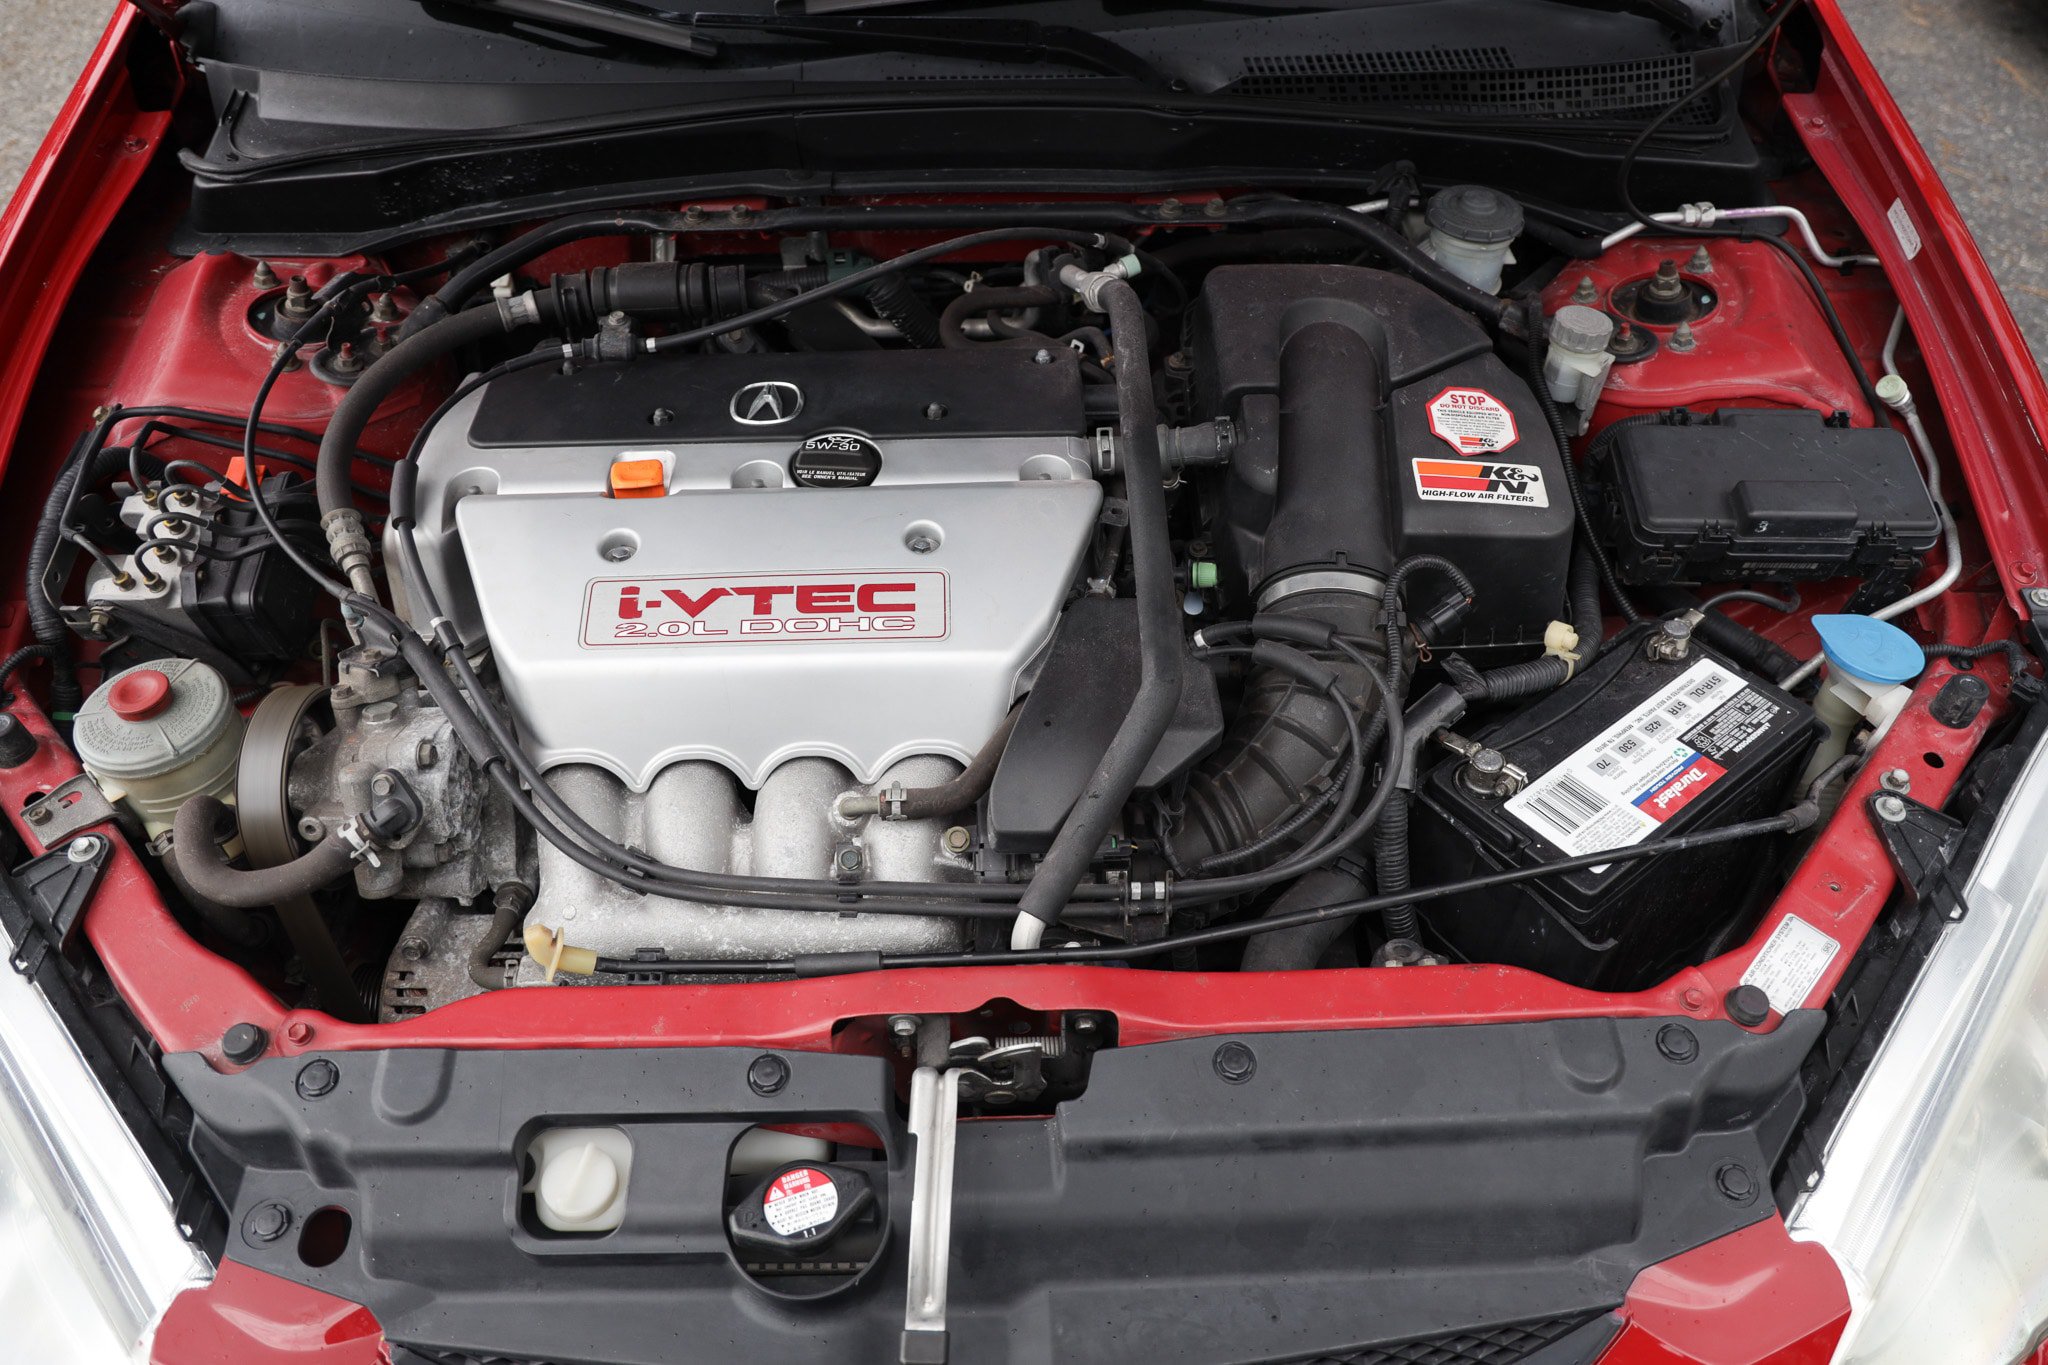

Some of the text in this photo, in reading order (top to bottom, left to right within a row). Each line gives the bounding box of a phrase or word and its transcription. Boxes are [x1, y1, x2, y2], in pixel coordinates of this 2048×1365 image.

[1450, 394, 1486, 405] STOP
[806, 441, 860, 451] 5W-30
[1422, 490, 1476, 498] HIGH-FLOW
[1497, 494, 1534, 502] FILTERS
[618, 582, 916, 619] i-VTEC
[614, 616, 916, 637] 2.0L DOHC
[1688, 675, 1722, 699] 51R-DL
[1666, 700, 1688, 716] 51R
[1643, 719, 1663, 733] 425
[1616, 738, 1637, 753] 530
[1594, 758, 1611, 770] 70
[1650, 765, 1708, 809] Duralast
[803, 1227, 816, 1238] 1.1
